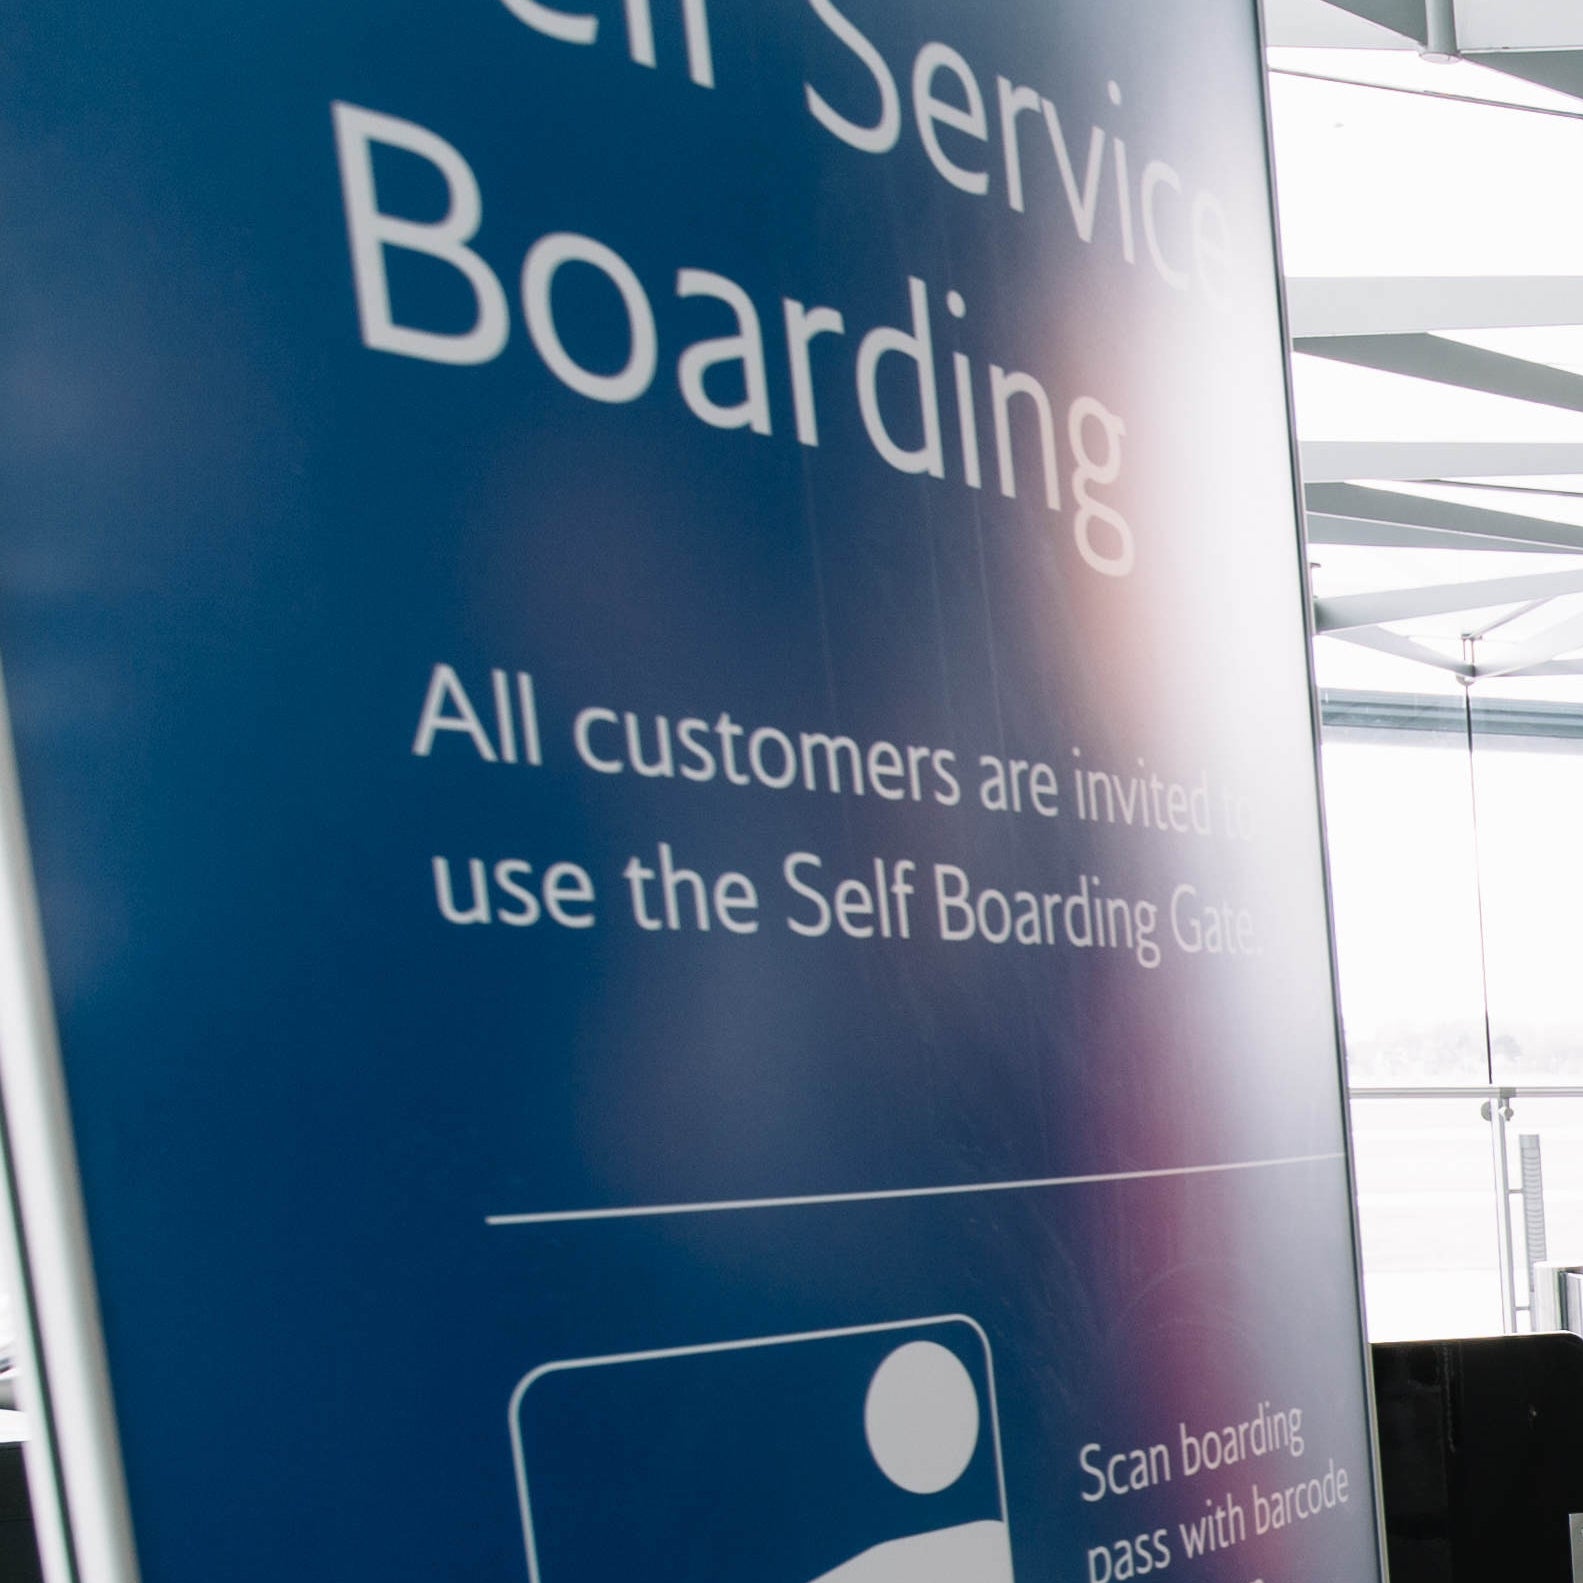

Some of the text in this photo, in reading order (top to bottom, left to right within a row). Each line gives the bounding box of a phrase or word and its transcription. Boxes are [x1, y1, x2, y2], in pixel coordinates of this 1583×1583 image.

[329, 99, 1136, 578] Boarding
[412, 664, 542, 765] All
[573, 705, 960, 805] customers
[979, 753, 1059, 817] are
[1073, 747, 1212, 837] invited
[432, 842, 1265, 968] use the Self Boarding Gate.
[1079, 1401, 1305, 1502] Scan boarding
[1179, 1492, 1246, 1559] with
[1252, 1458, 1350, 1535] barcode
